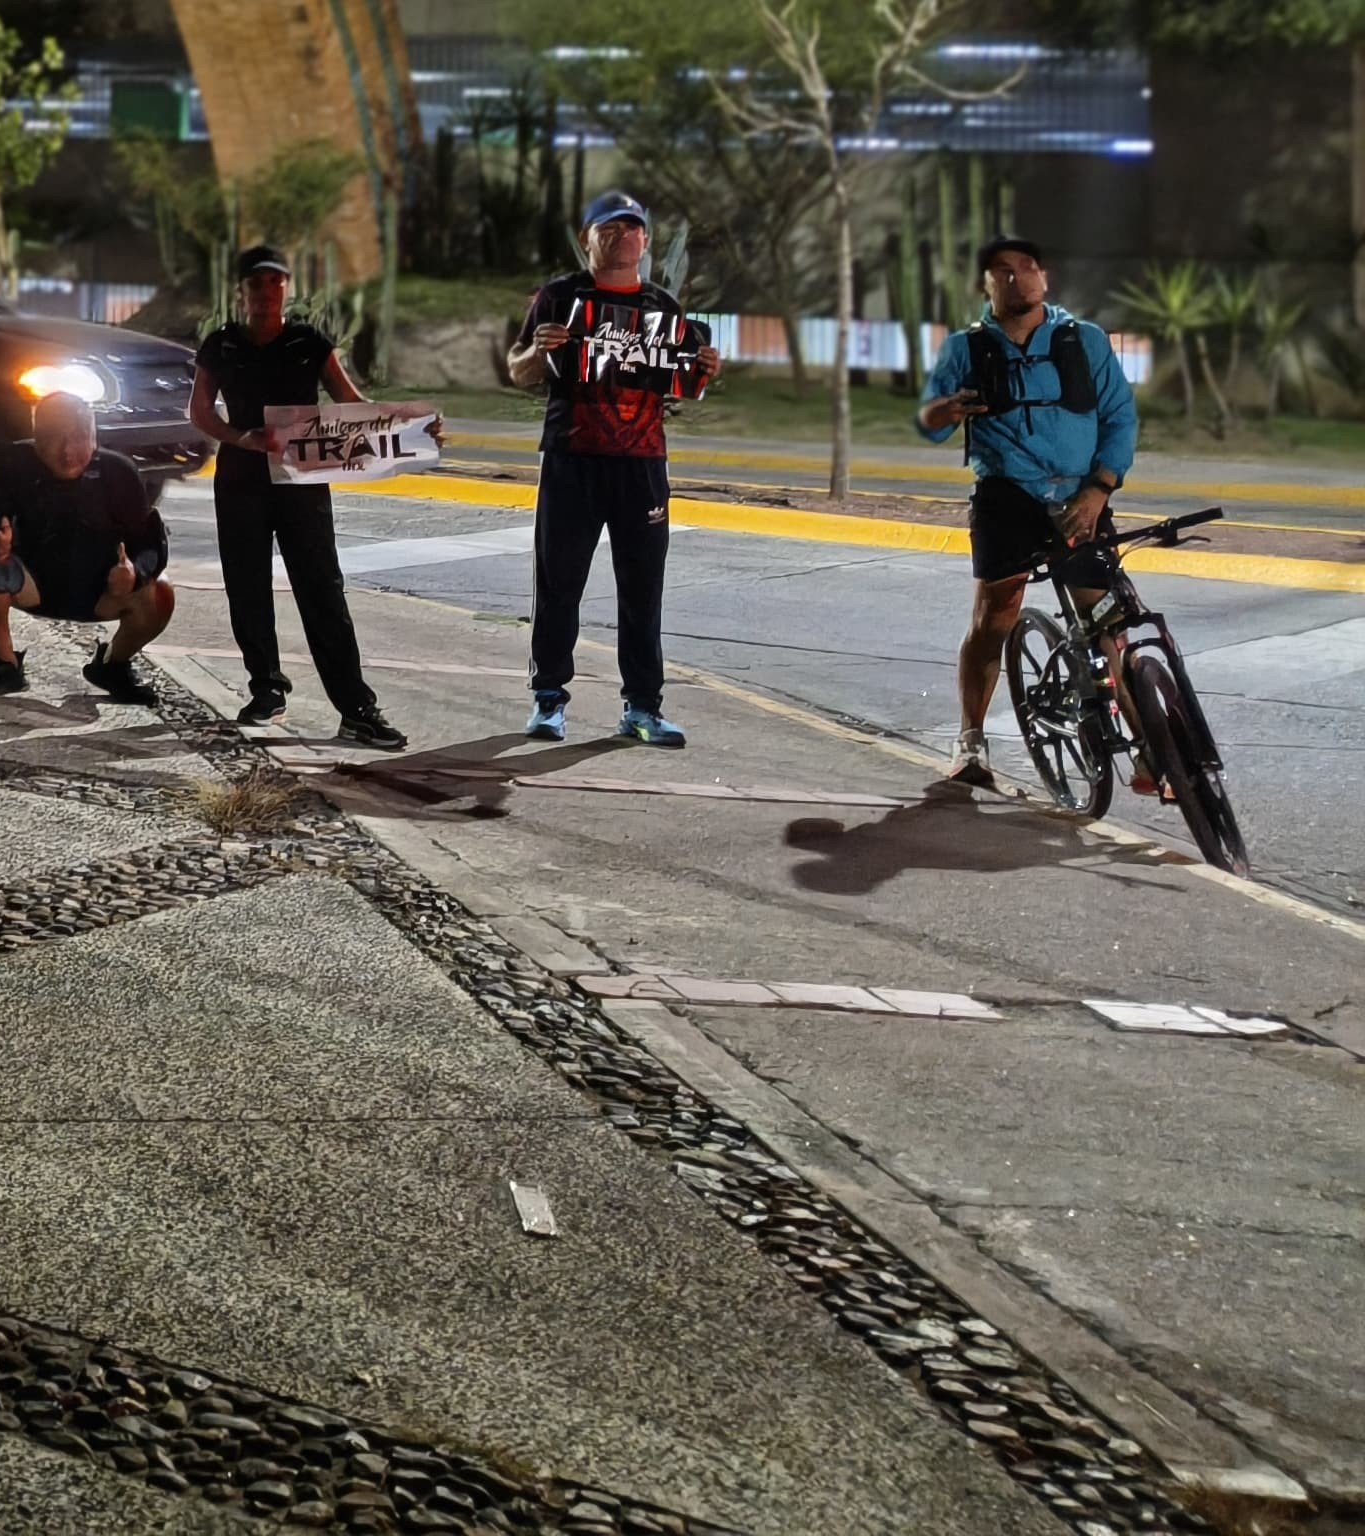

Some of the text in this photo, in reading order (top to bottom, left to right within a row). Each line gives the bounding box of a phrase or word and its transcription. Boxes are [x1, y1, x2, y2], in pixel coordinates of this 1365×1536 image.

[594, 322, 642, 349] Amigos
[583, 336, 679, 370] TRAIL
[302, 416, 363, 440] Amigos
[287, 433, 417, 462] TRAIL
